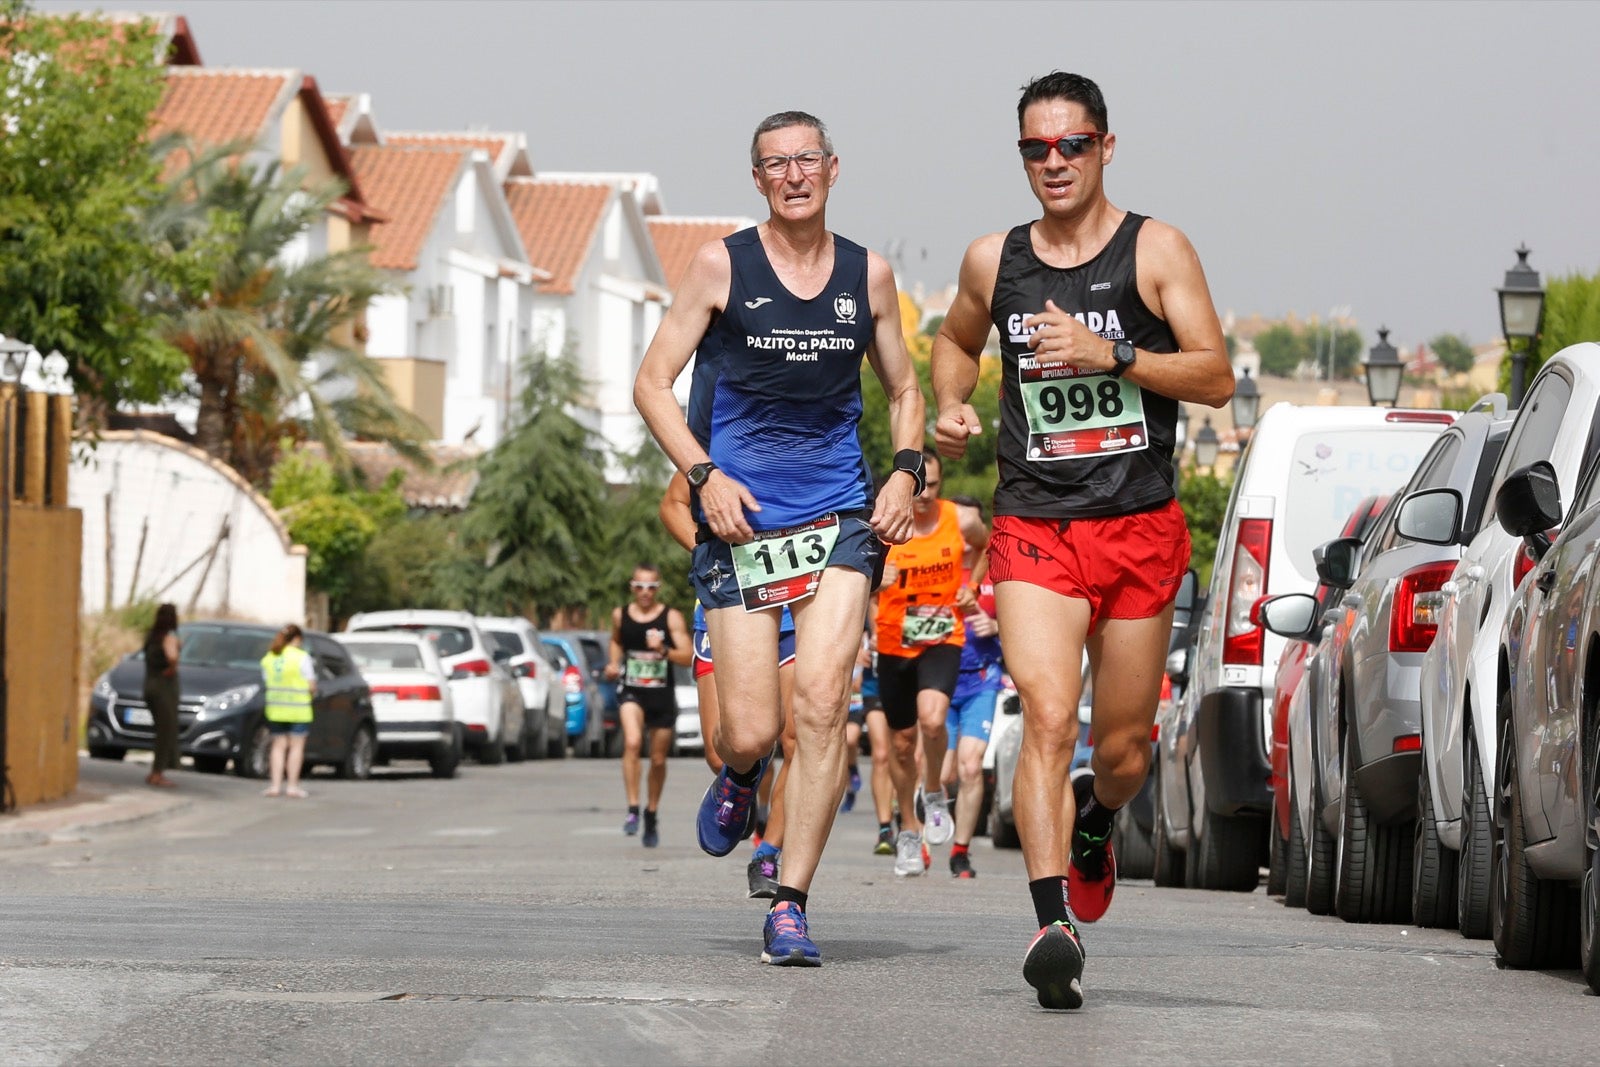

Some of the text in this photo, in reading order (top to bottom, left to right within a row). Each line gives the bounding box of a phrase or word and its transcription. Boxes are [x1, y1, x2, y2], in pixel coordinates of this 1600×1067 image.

[838, 298, 853, 312] 30
[1007, 309, 1122, 336] GRADA
[805, 328, 834, 336] Deportiva
[1095, 331, 1125, 339] ROJECT
[747, 336, 855, 351] PAZITO a PAZITO
[786, 352, 818, 362] Motril
[1039, 380, 1124, 425] 998
[753, 534, 827, 575] 113
